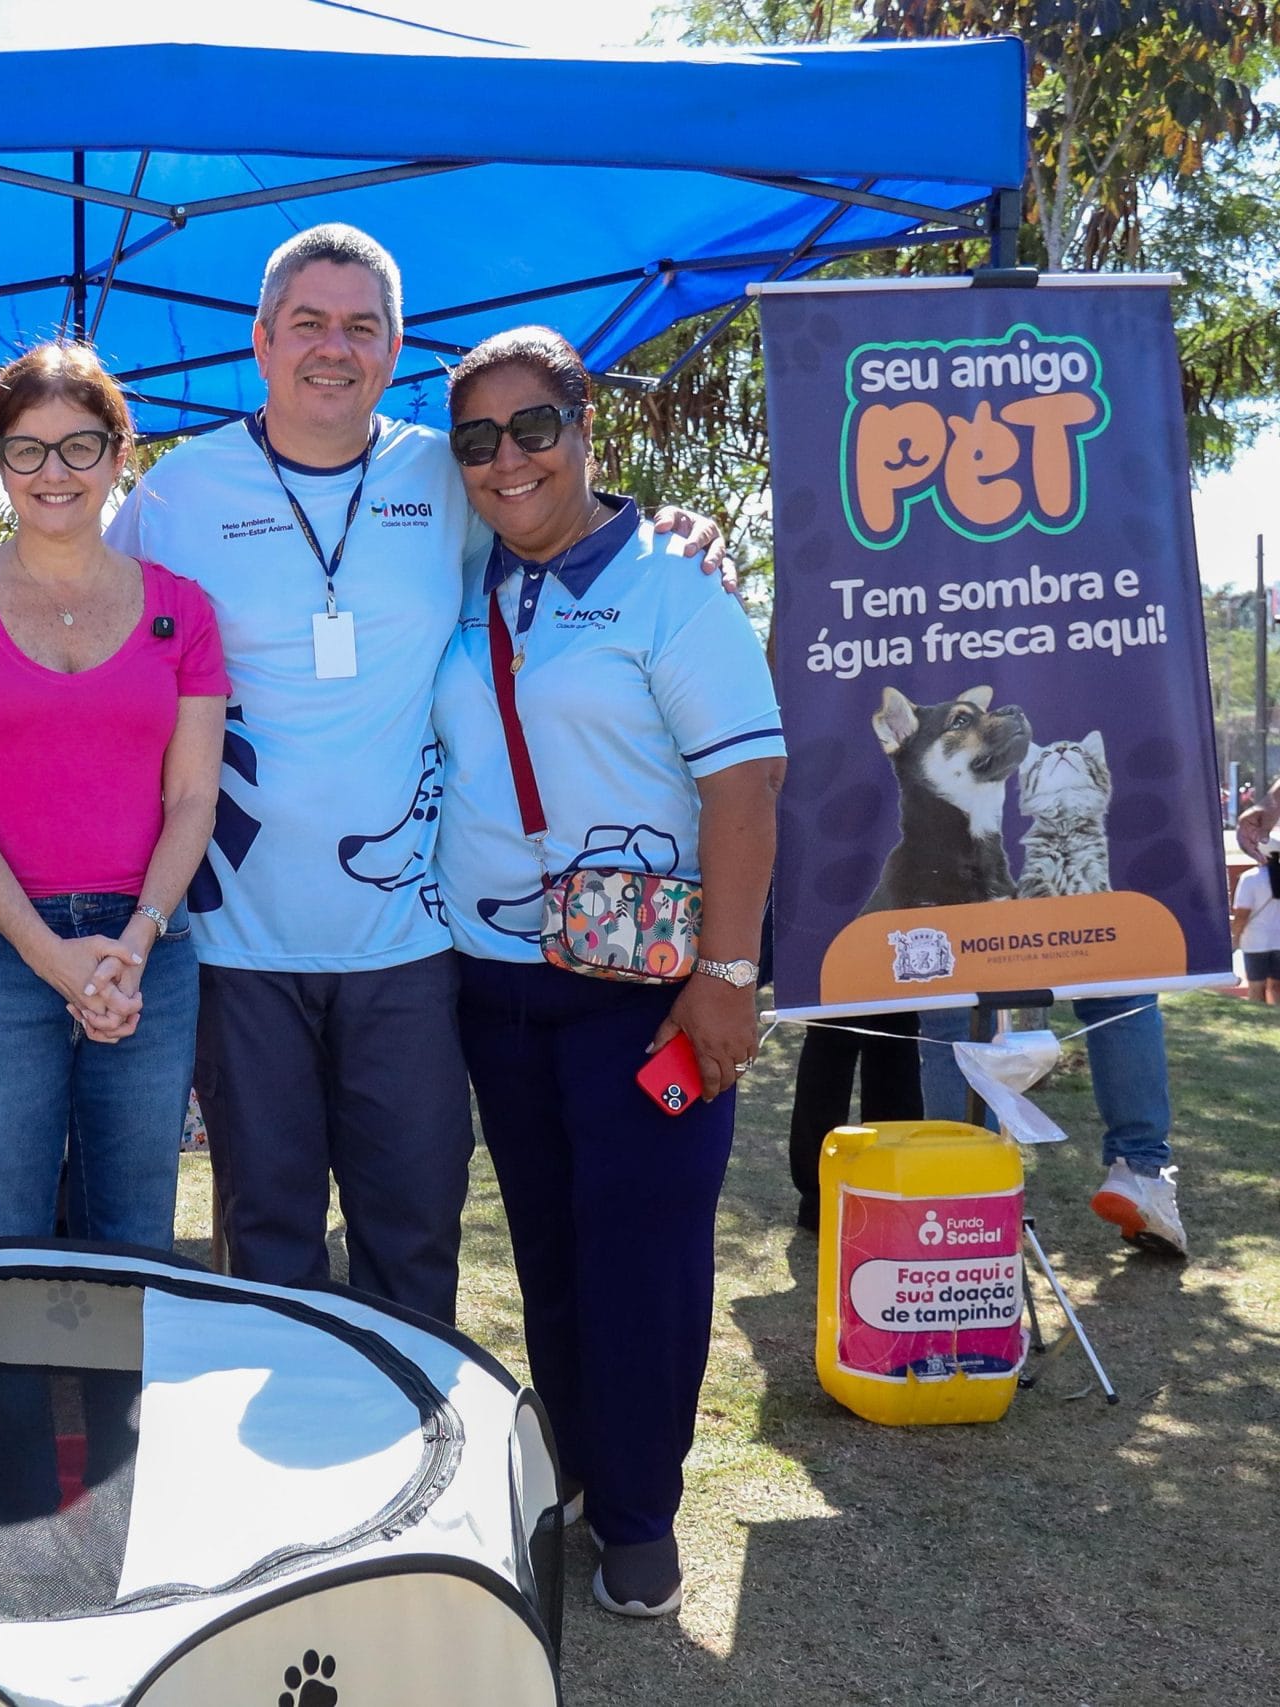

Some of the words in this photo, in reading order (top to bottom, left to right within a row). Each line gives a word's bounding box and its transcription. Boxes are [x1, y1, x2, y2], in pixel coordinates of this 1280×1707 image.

[860, 357, 939, 393] seu
[950, 339, 1088, 395] amigo
[391, 502, 433, 518] MOGI
[241, 517, 276, 528] Ambiente
[268, 523, 294, 533] Animal
[830, 578, 926, 620] Tem
[938, 565, 1104, 613] sombra
[1114, 568, 1139, 597] e
[572, 607, 621, 623] MOGI
[806, 628, 912, 679] água
[922, 623, 1056, 662] fresca
[1067, 605, 1167, 656] aqui!
[960, 936, 1005, 954] MOGI
[1008, 933, 1044, 950] DAS
[1047, 927, 1117, 946] CRUZES
[947, 1218, 984, 1229] Fundo
[947, 1228, 1001, 1245] Social
[898, 1268, 950, 1288] Faça
[955, 1263, 1000, 1284] aqui
[895, 1290, 934, 1304] sua
[881, 1306, 910, 1323] de
